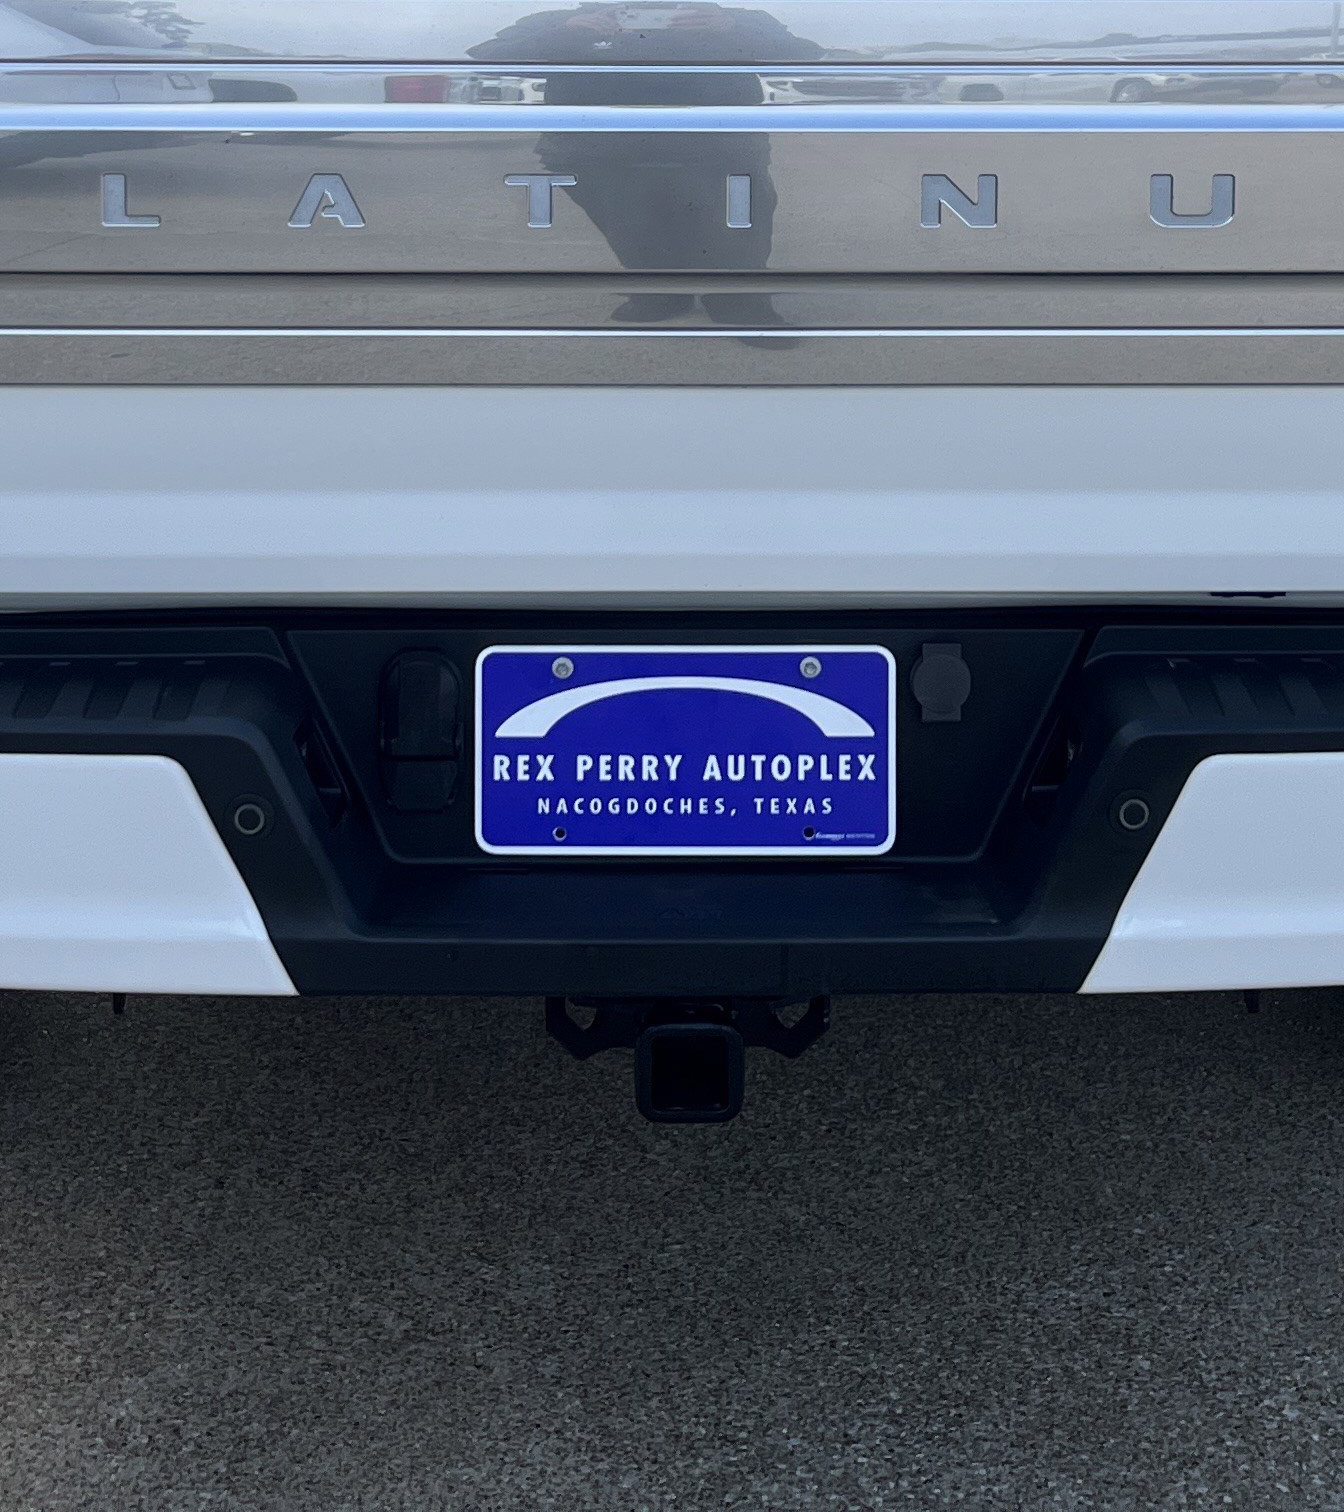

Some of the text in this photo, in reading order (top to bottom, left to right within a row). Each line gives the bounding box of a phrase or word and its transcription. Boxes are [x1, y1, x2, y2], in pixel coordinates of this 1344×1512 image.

[492, 753, 877, 782] REX PERRY AUTOPLEX
[537, 797, 834, 817] NACOGDOCHES, TEXAS
